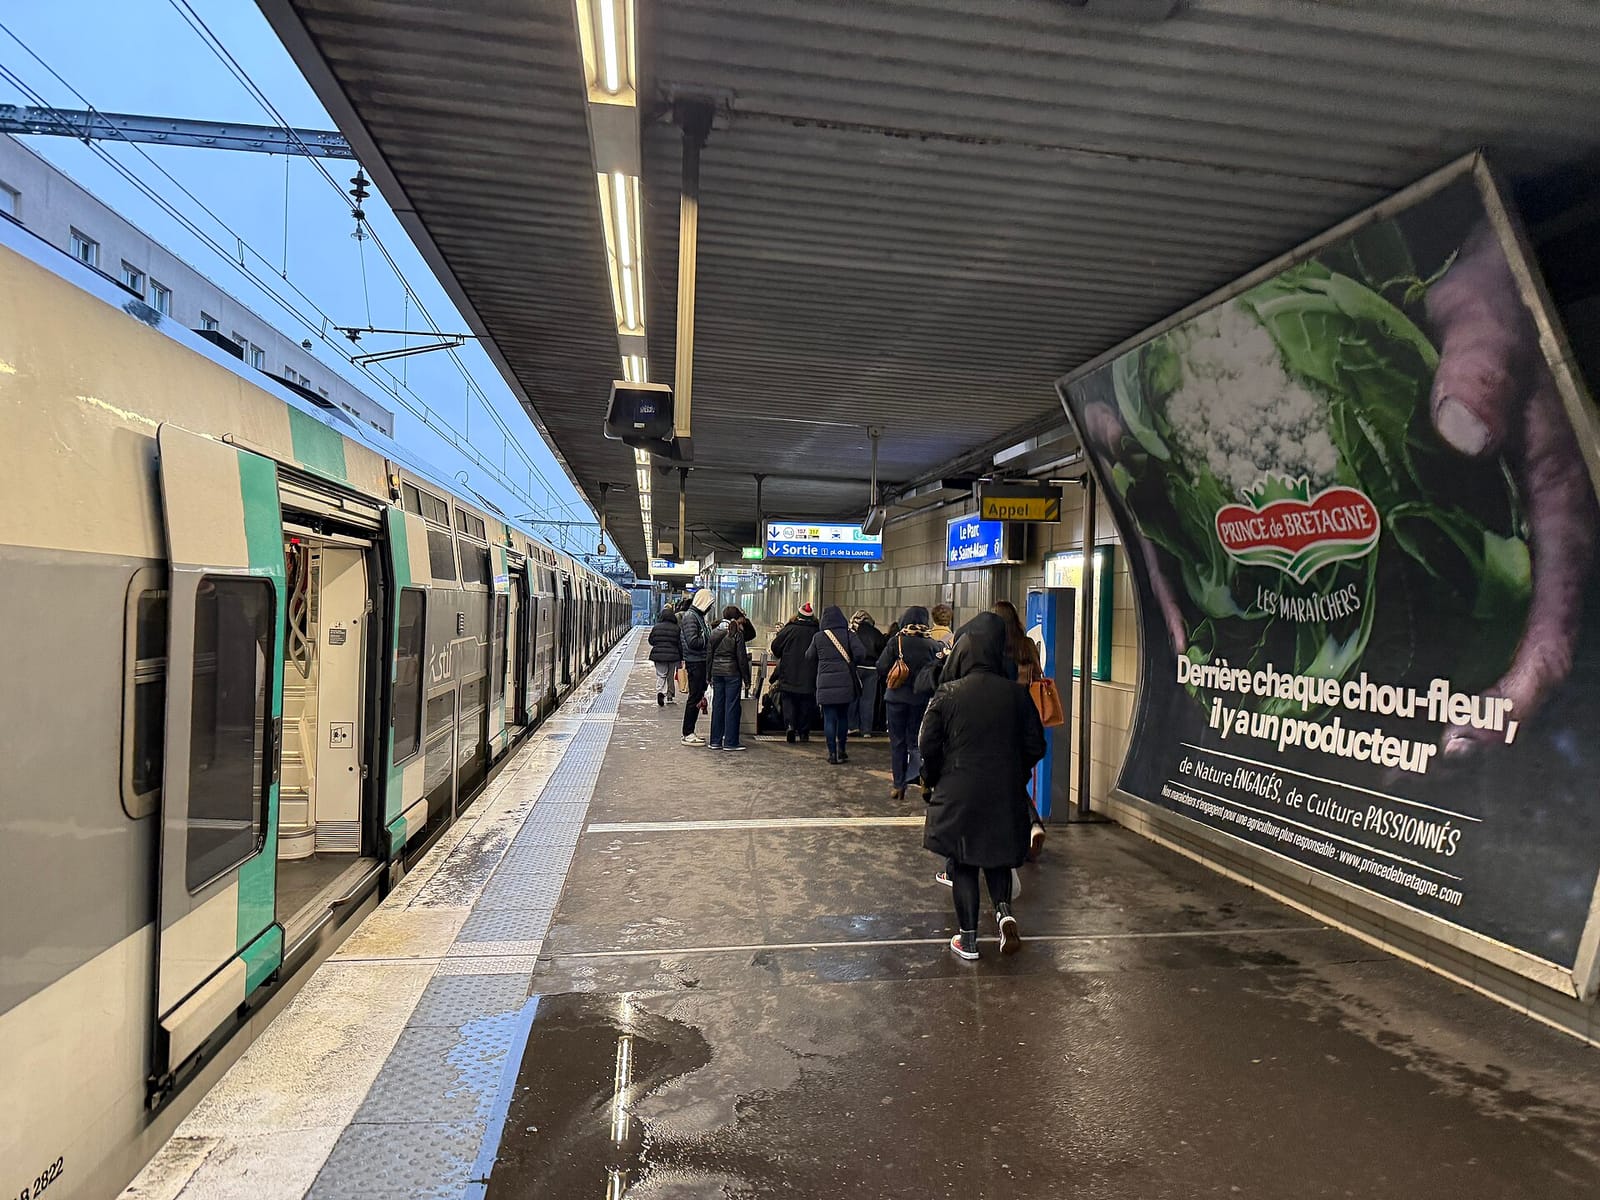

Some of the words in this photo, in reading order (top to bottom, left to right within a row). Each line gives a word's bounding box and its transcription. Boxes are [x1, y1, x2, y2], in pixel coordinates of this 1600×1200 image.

[988, 503, 1029, 518] Appel
[1220, 517, 1270, 544] PRINCE
[1269, 517, 1286, 539] de
[1282, 504, 1373, 538] BRETAGNE
[782, 543, 819, 556] Sortie
[951, 547, 959, 561] de
[958, 542, 989, 560] Saint-Maur
[960, 525, 967, 540] Le
[967, 523, 980, 538] Parc
[1257, 584, 1277, 615] LES
[1279, 583, 1361, 623] MARAÎCHERS
[1177, 654, 1251, 694] Derrière
[1253, 663, 1340, 712] chaque
[1342, 672, 1519, 744] chou-fleur,
[1209, 697, 1222, 729] il
[1220, 707, 1236, 739] y
[1234, 710, 1250, 735] a
[1250, 712, 1280, 741] un
[1278, 717, 1437, 774] producteur
[1179, 757, 1193, 775] de
[1194, 761, 1233, 787] Nature
[1232, 767, 1283, 803] ENGAGÉS,
[1285, 788, 1303, 808] de
[1307, 793, 1364, 828] Culture
[1363, 805, 1461, 857] PASSIONNÉS
[1221, 808, 1238, 821] pour
[1235, 813, 1248, 826] une
[1246, 817, 1280, 838] agriculture
[1278, 827, 1295, 843] plus
[1293, 833, 1336, 858] responsable
[1339, 850, 1463, 906] www.princedebretagne.com
[33, 1156, 64, 1199] 2822
